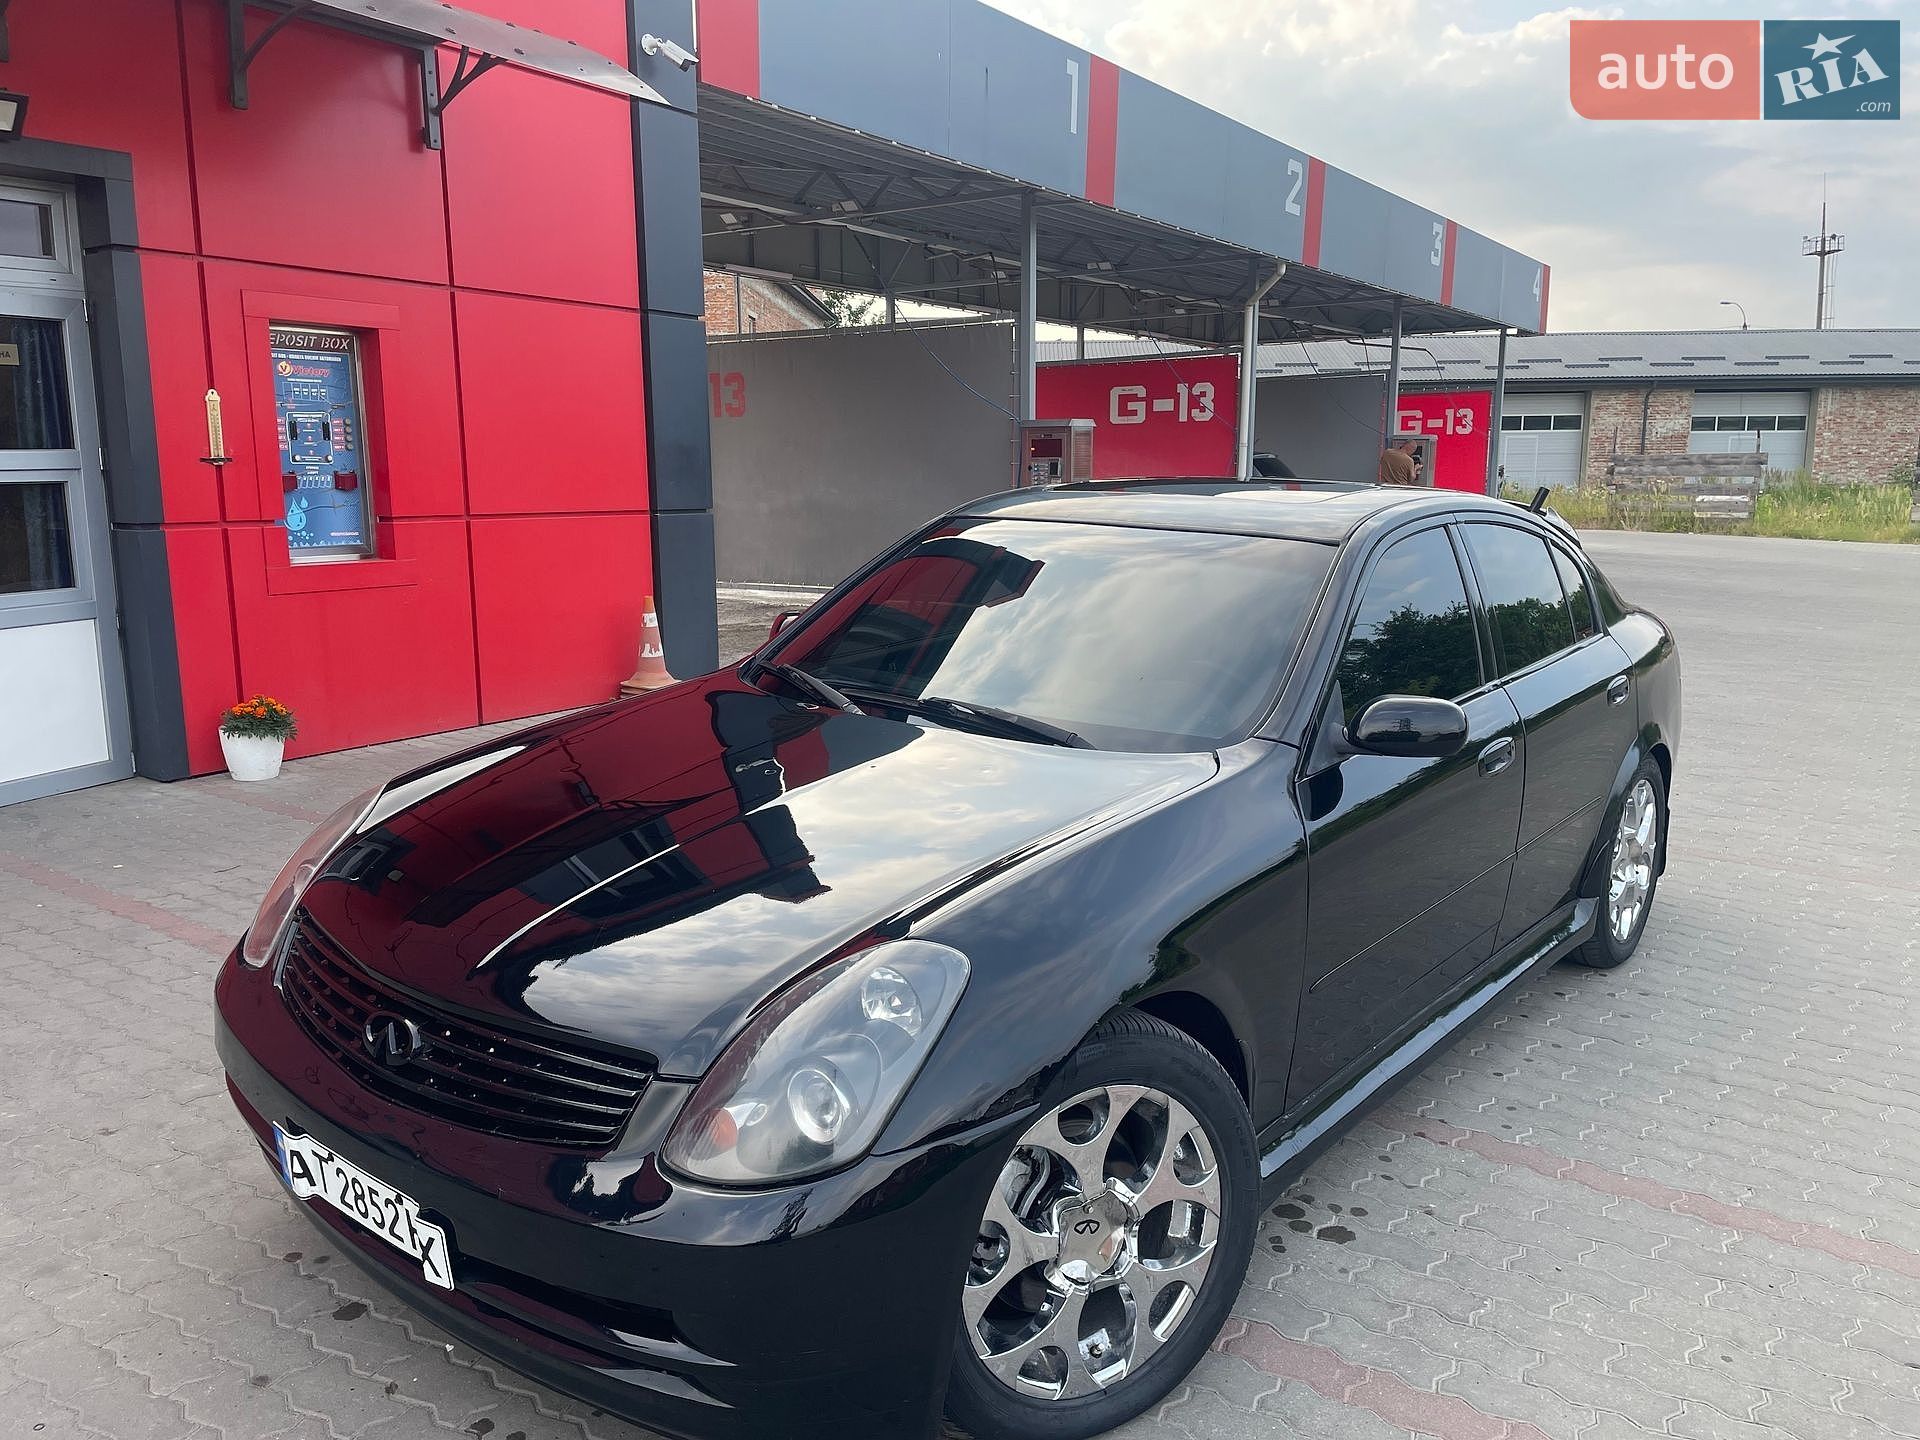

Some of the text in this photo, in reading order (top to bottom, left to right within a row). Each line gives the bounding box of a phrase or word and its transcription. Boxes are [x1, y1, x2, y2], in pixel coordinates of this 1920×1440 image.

[1066, 58, 1079, 134] 1
[1285, 158, 1303, 216] 2
[1430, 222, 1443, 266] 3
[1532, 266, 1540, 302] 4
[320, 337, 350, 350] BOX
[293, 364, 330, 378] Victory
[1109, 382, 1215, 425] G-13
[1394, 408, 1474, 436] G-13
